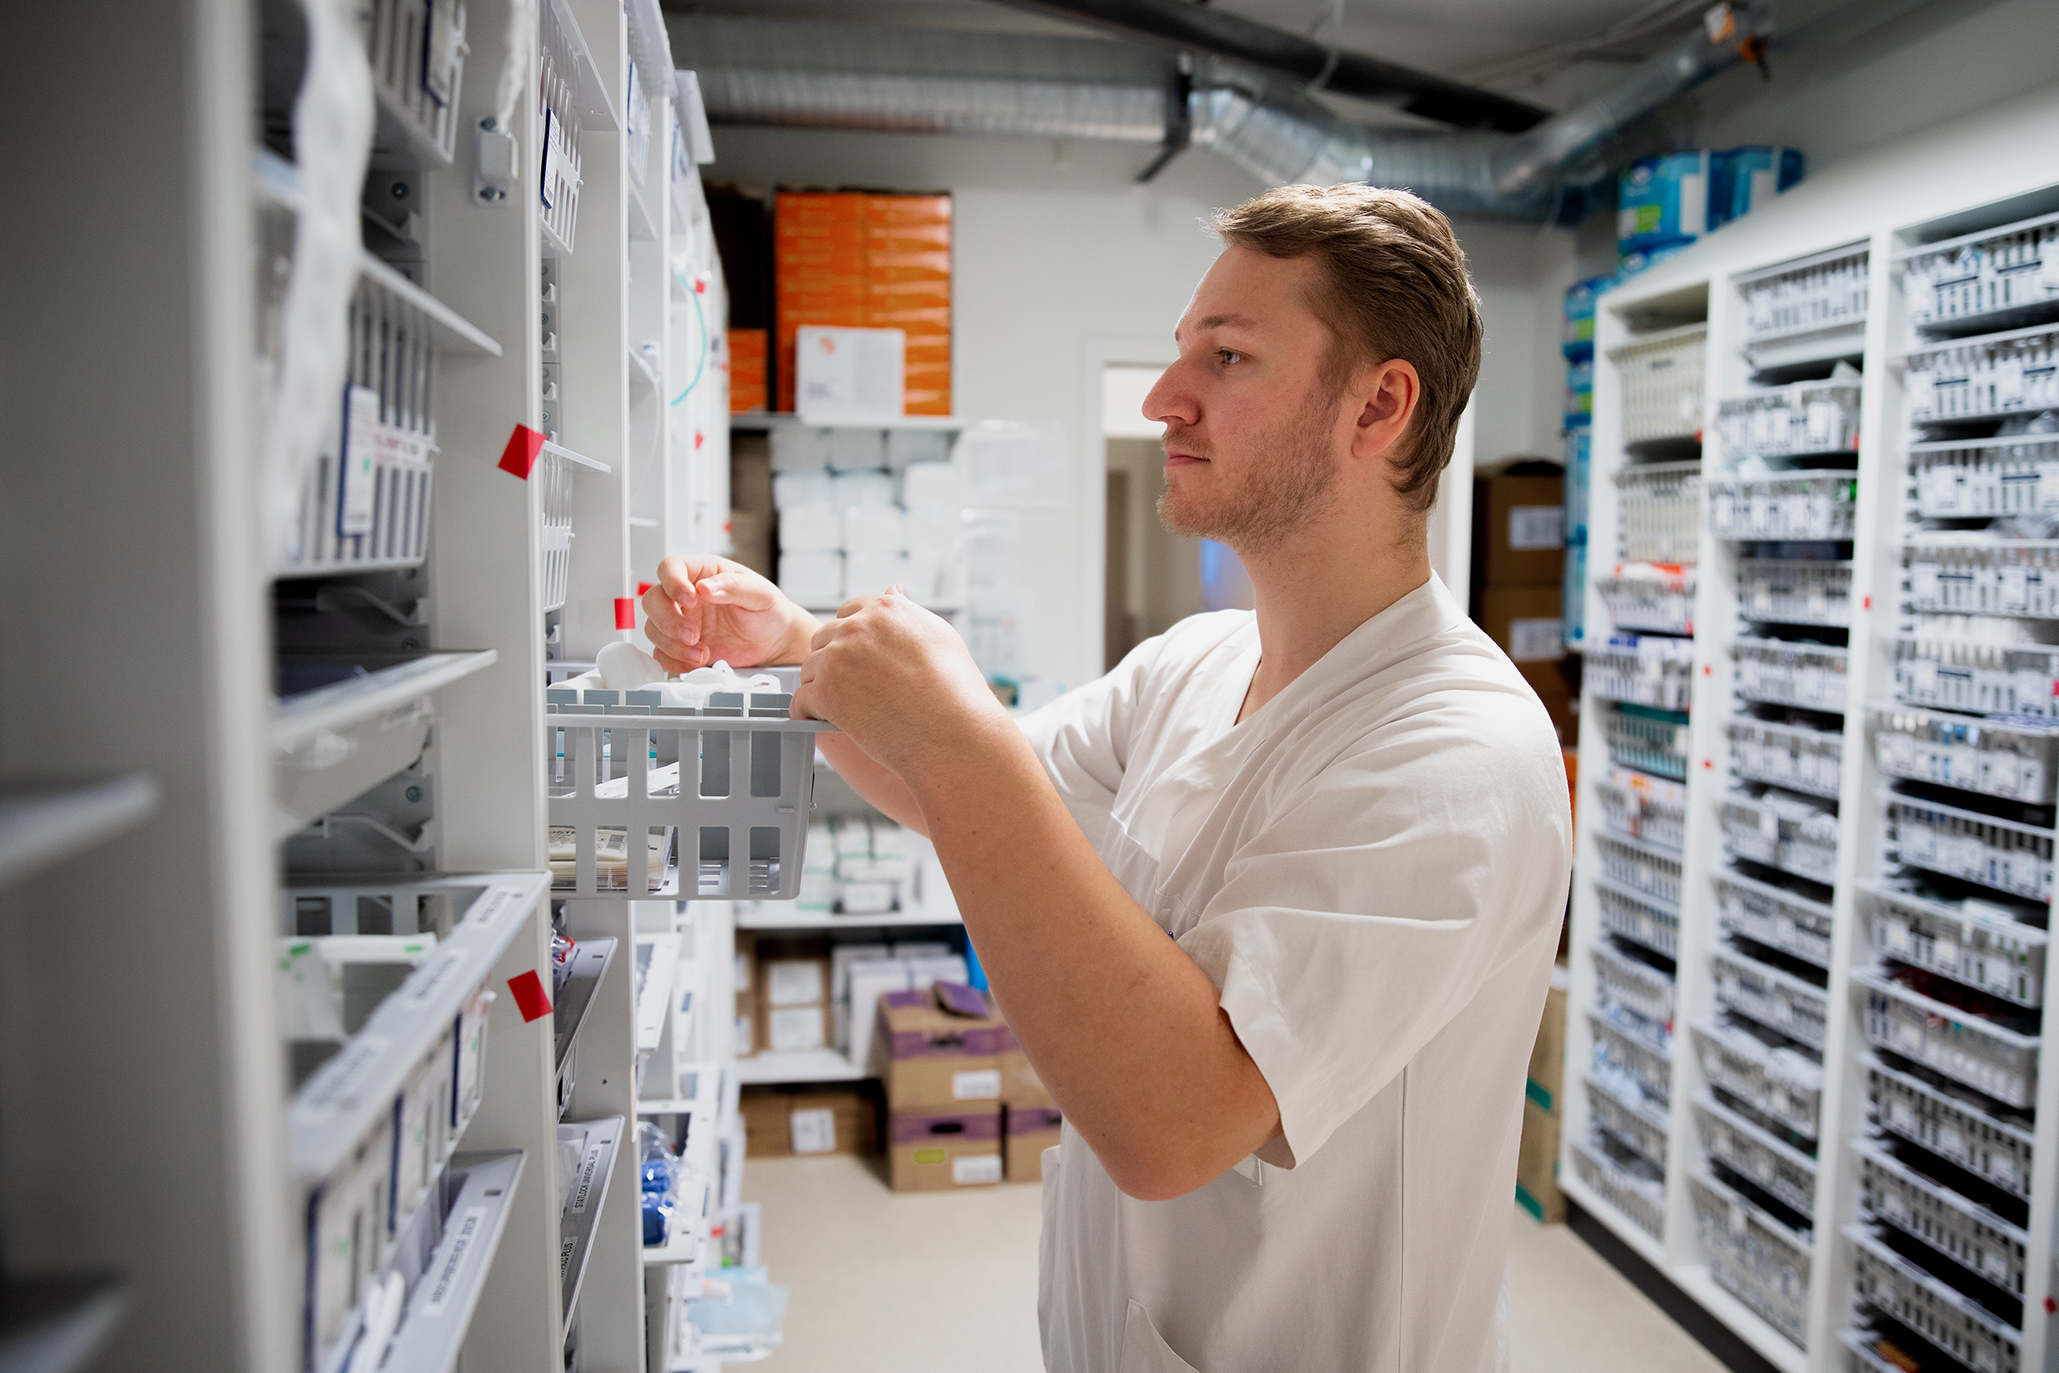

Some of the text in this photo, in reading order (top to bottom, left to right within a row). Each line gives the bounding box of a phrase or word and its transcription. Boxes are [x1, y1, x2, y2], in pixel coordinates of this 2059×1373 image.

[574, 1149, 599, 1209] STATLOCK UNIVERSAL PLUS
[561, 1242, 573, 1256] PLUS
